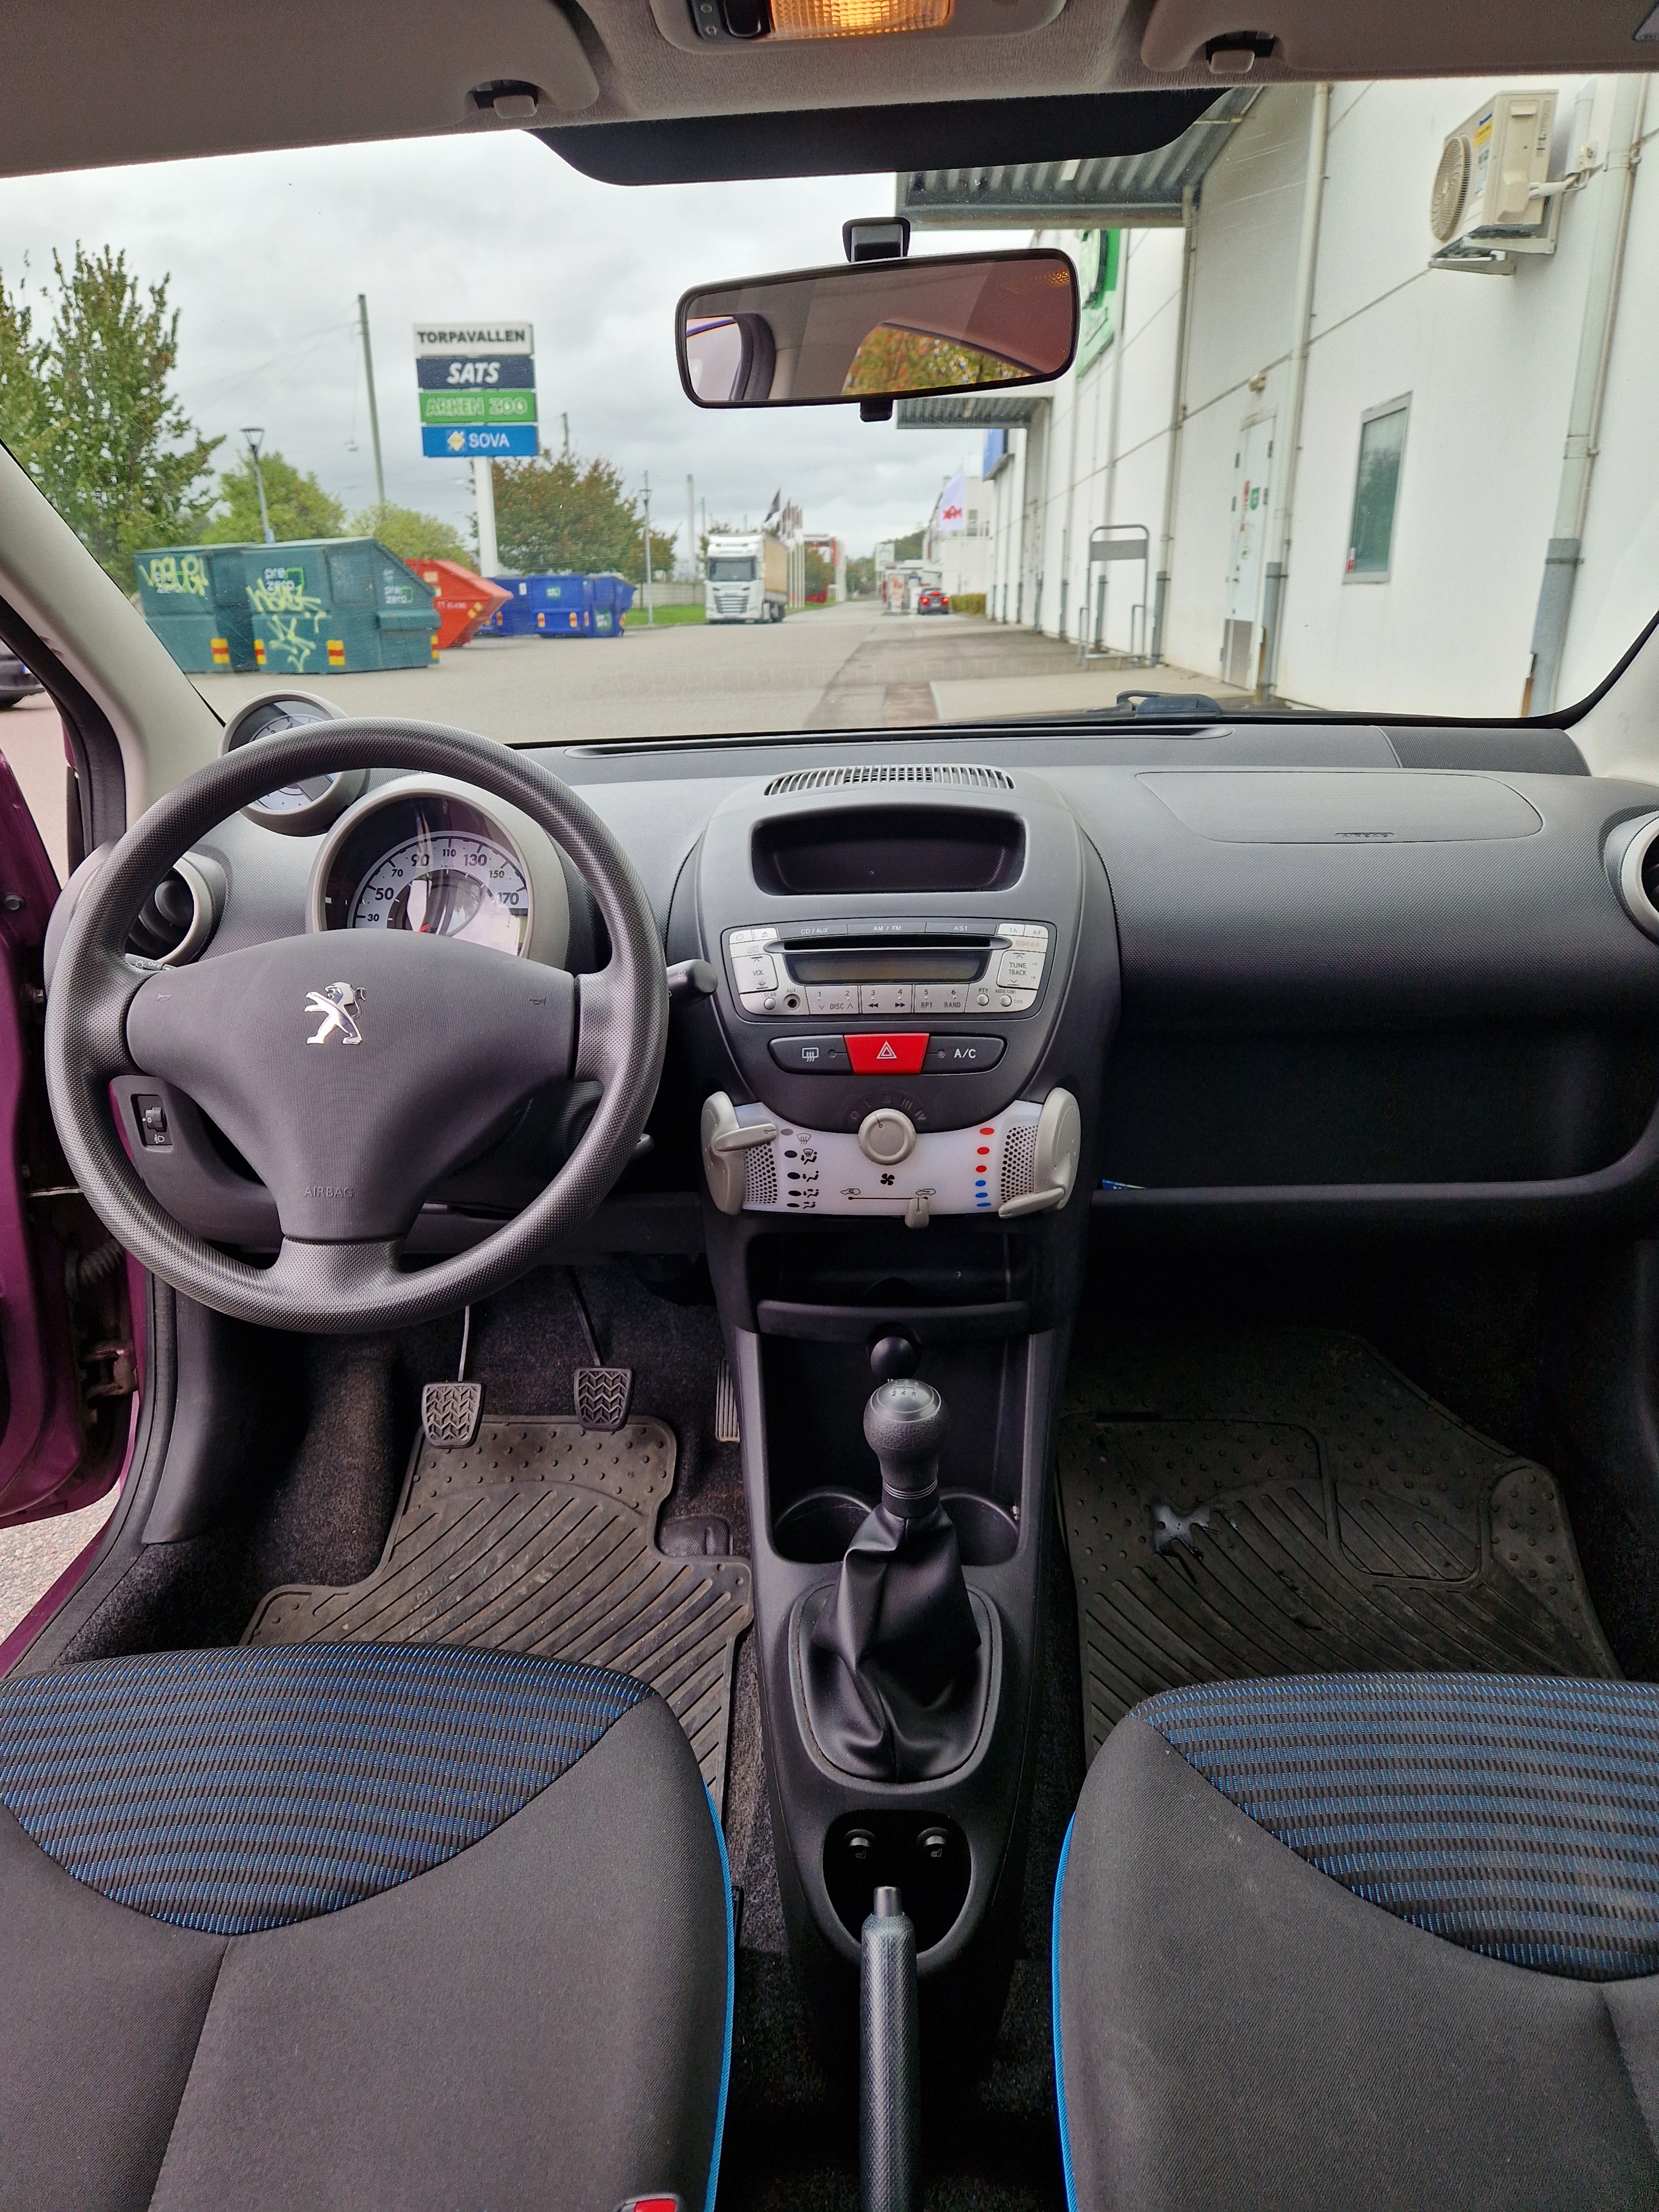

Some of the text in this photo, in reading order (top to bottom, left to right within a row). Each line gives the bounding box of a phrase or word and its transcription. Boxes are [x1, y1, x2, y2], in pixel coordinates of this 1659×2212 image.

[418, 329, 525, 343] TORPAVALLEN
[446, 362, 500, 384] SATS
[425, 397, 528, 417] ARKEN ZOO
[469, 432, 510, 448] SOVA
[442, 849, 456, 857] 110
[411, 853, 430, 867] 90
[463, 854, 487, 867] 130
[391, 869, 404, 877] 70
[489, 870, 505, 879] 150
[375, 887, 394, 901] 50
[498, 892, 520, 905] 170
[367, 914, 379, 922] 30
[953, 1047, 977, 1059] A/C
[304, 1186, 354, 1198] AIRBAG
